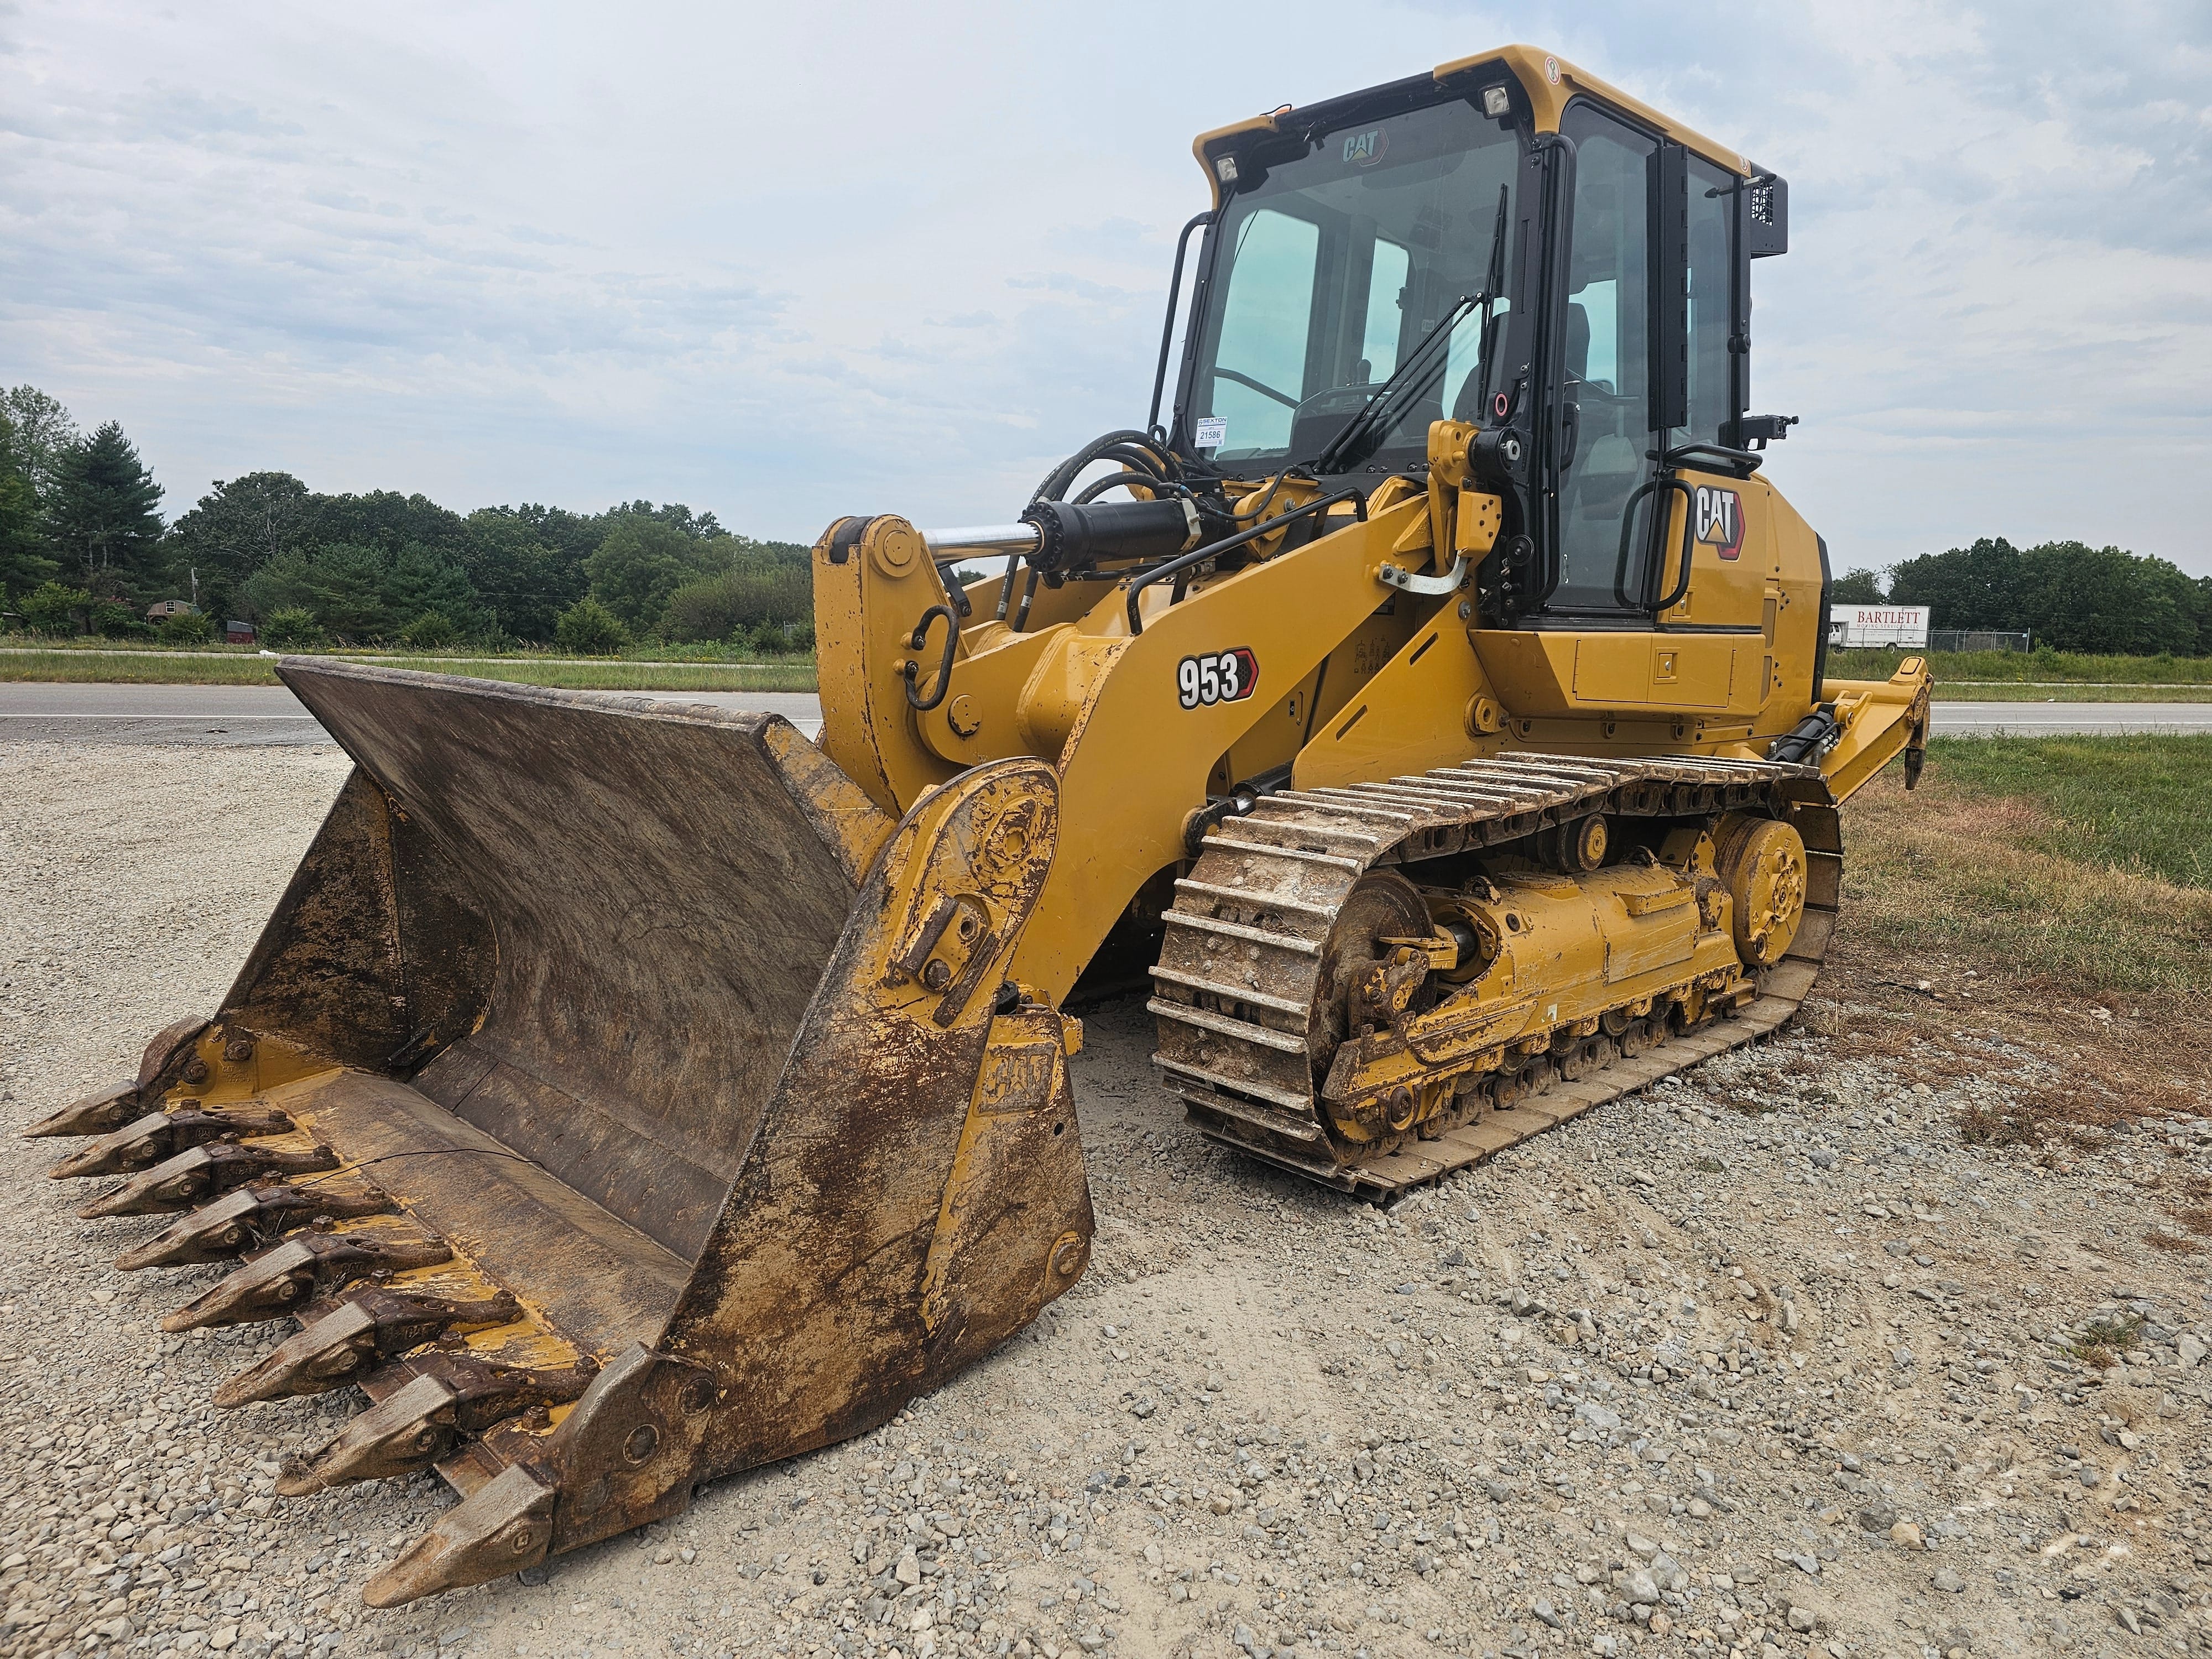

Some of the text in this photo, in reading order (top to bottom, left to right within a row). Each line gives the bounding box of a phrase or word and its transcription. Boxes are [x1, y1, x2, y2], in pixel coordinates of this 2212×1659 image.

[1343, 131, 1378, 162] CAT
[1200, 431, 1220, 439] 21586
[1697, 487, 1734, 543] CAT
[1858, 611, 1921, 624] BARTLETT
[1180, 654, 1238, 706] 953
[985, 1054, 1048, 1104] CAT
